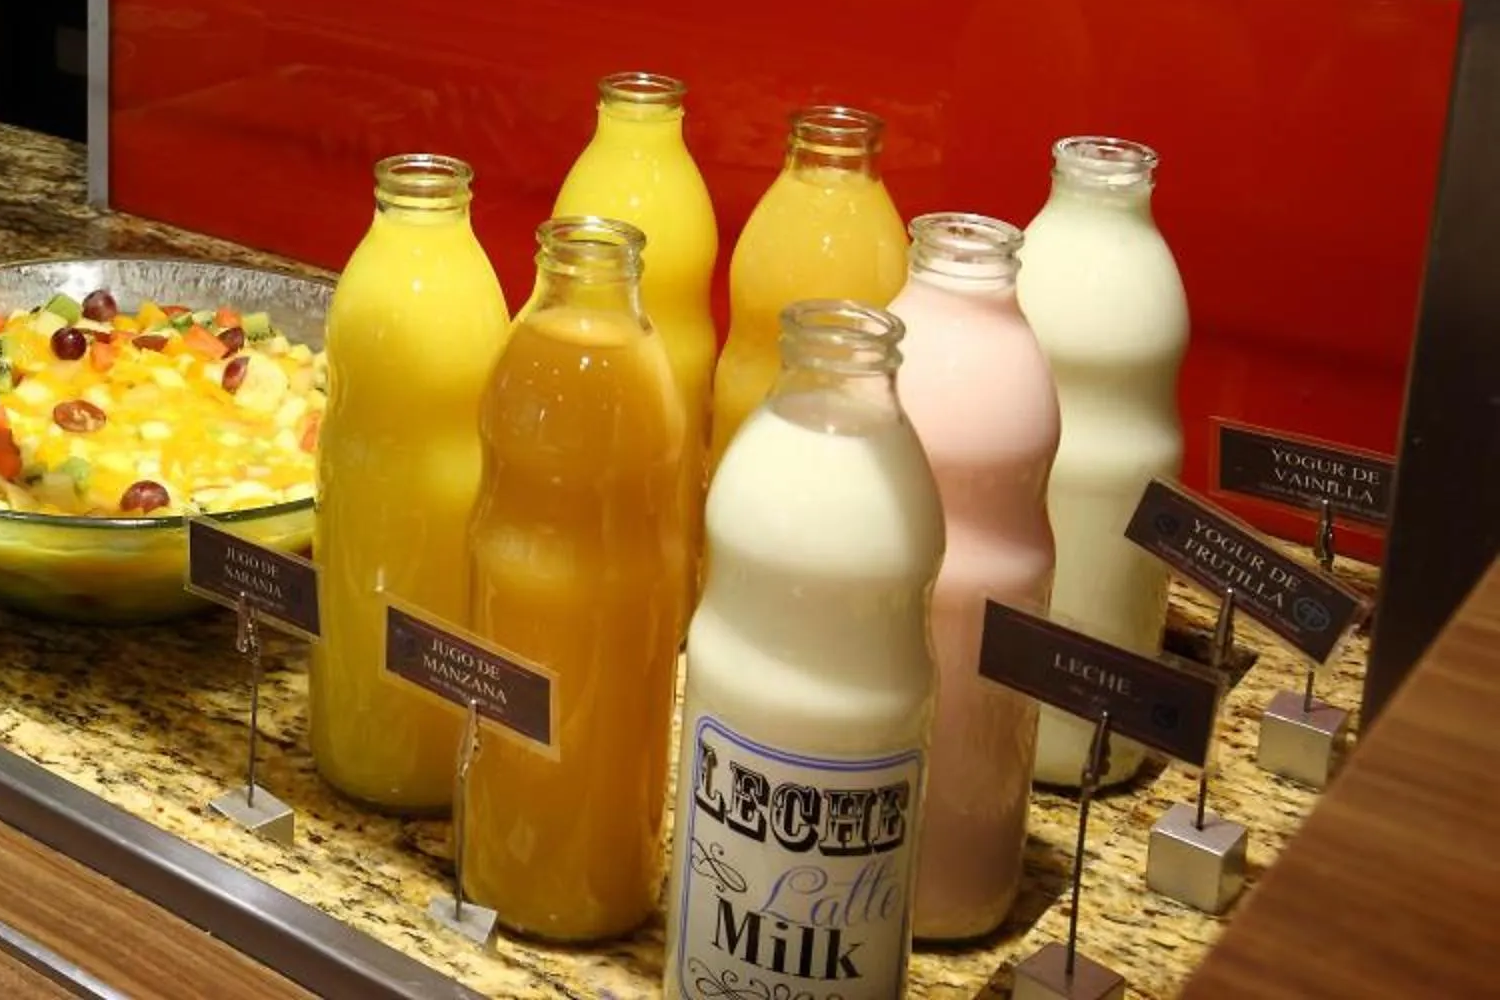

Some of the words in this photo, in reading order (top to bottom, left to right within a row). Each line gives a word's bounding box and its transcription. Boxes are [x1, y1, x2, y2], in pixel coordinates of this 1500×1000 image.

[1271, 447, 1347, 477] YOGUR
[1352, 467, 1381, 485] DE
[1274, 467, 1374, 504] VAINILLA
[226, 546, 260, 570] JUGO
[261, 560, 279, 578] DE
[1184, 538, 1283, 610] FRUTILLA
[1193, 518, 1266, 572] YOGUR
[1269, 566, 1300, 592] DE
[224, 564, 283, 599] NARANJA
[422, 652, 508, 705] MANZANA
[432, 638, 475, 668] JUGO
[476, 659, 501, 681] DE
[1052, 652, 1132, 697] LECHE
[695, 743, 910, 857] LECHE
[758, 859, 901, 927] Latte
[711, 894, 867, 981] Milk
